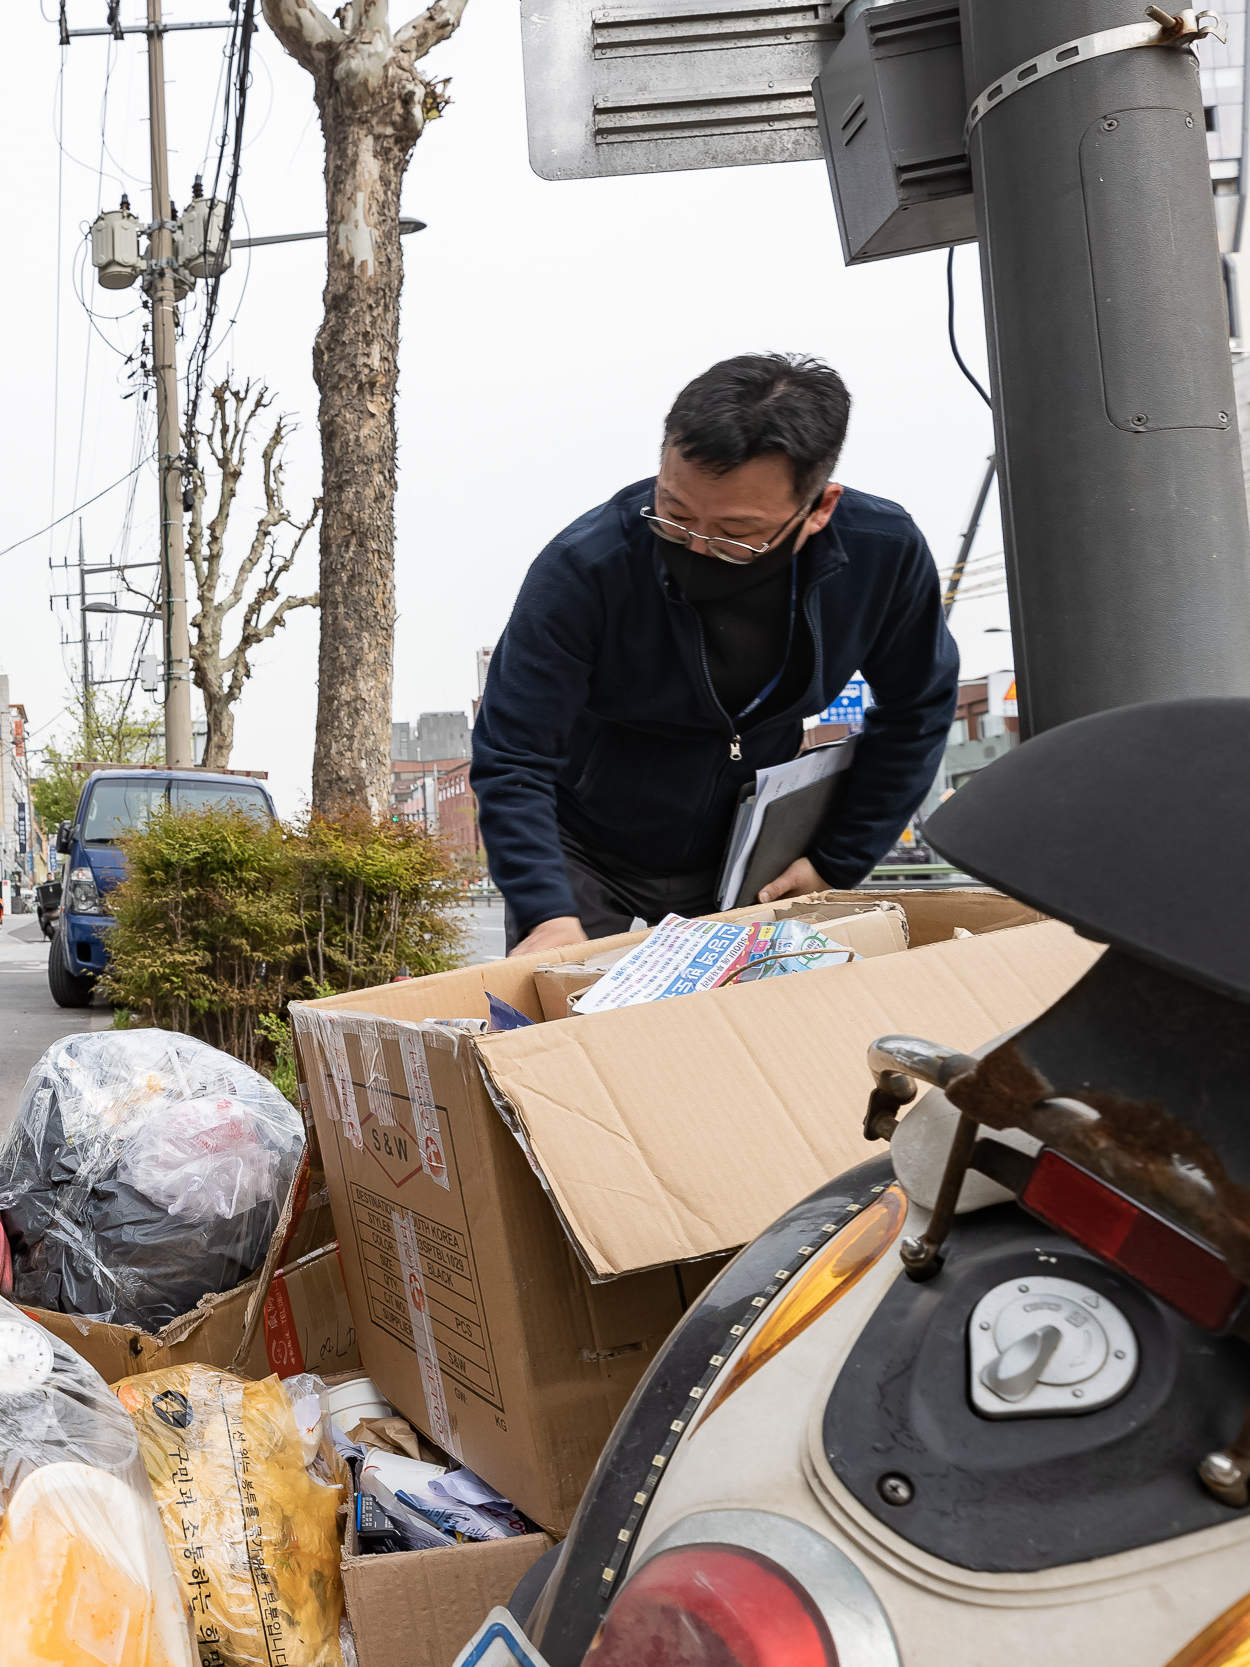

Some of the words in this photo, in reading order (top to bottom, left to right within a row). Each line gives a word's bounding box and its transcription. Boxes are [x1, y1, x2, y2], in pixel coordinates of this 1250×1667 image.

[695, 923, 741, 966] 신당역
[411, 1215, 431, 1236] OUTH
[431, 1225, 460, 1250] KOREA
[427, 1261, 454, 1287] BLACK
[455, 1317, 473, 1337] PCS
[232, 1429, 247, 1443] 선
[494, 1414, 508, 1432] KG
[236, 1448, 251, 1475] 위는
[168, 1447, 199, 1510] 구민과
[181, 1518, 213, 1615] 소통하는
